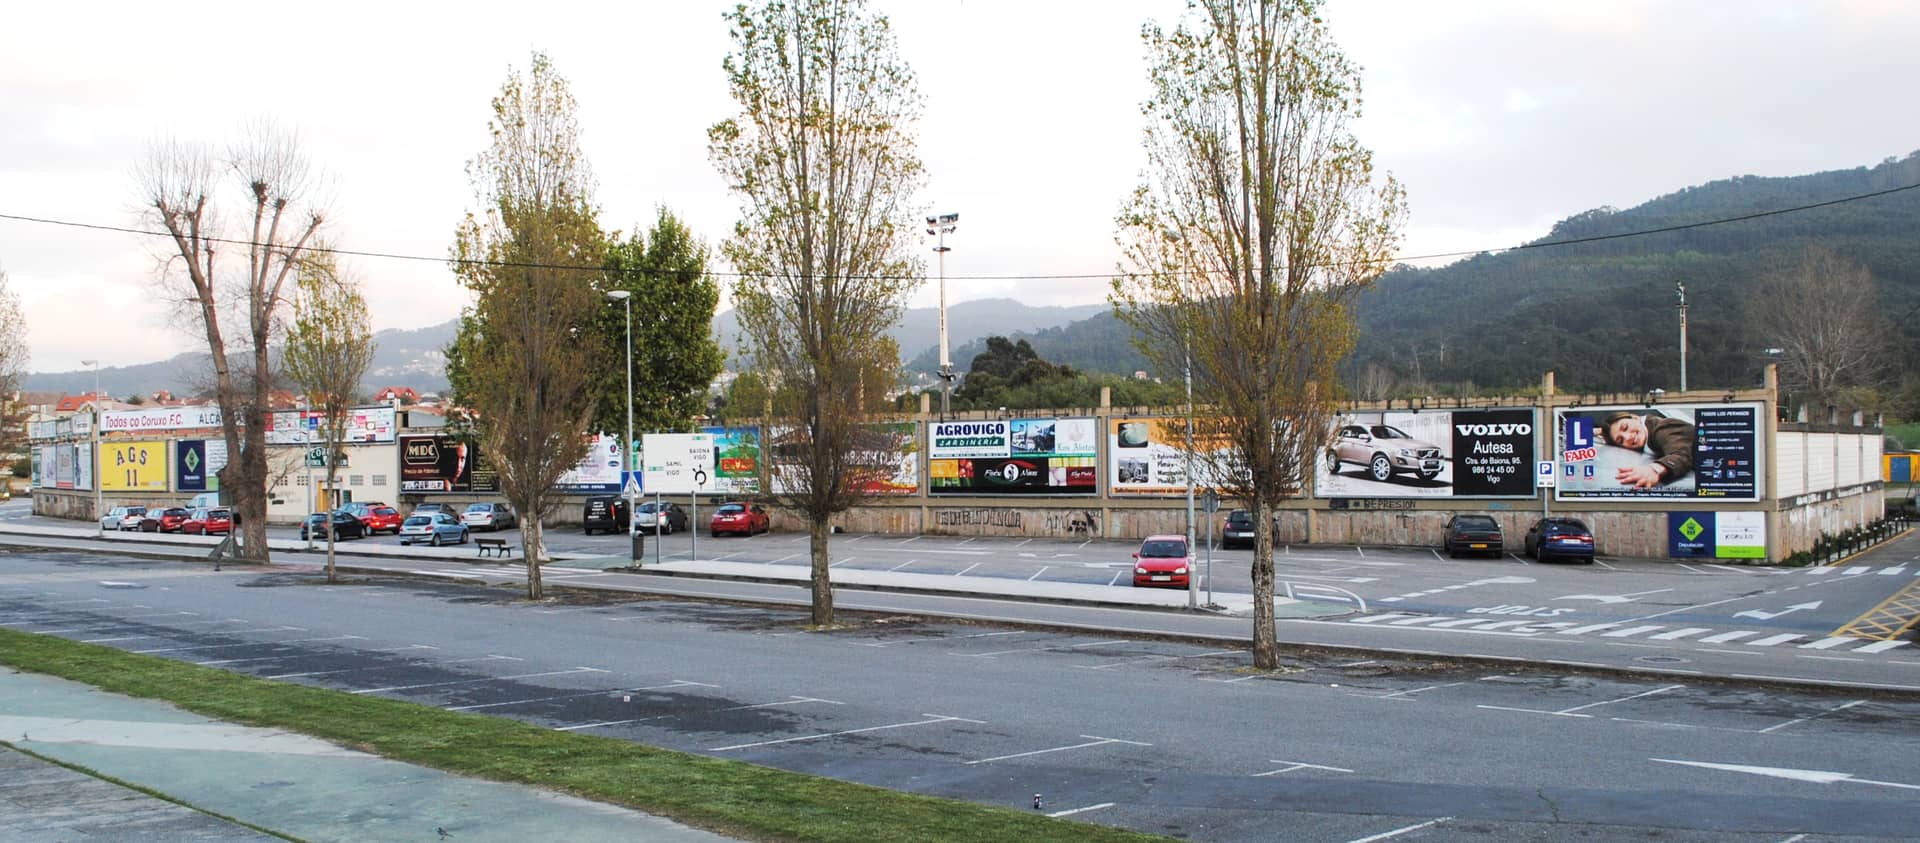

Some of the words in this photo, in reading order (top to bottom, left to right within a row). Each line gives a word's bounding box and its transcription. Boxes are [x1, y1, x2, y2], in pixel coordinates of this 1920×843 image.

[106, 416, 127, 428] Todos
[141, 416, 167, 426] Coruxo
[199, 413, 223, 424] ALCA
[936, 423, 1005, 436] AGROVIGO
[1456, 423, 1531, 436] VOLVO
[1574, 421, 1587, 445] L
[408, 445, 434, 456] MDC
[1473, 440, 1514, 454] Autesa
[1480, 457, 1488, 465] de
[1565, 449, 1596, 462] FARO
[1486, 466, 1495, 474] 24
[1496, 466, 1505, 474] 45
[1542, 464, 1550, 474] P
[127, 469, 138, 487] 11
[1487, 475, 1500, 484] Vigo
[1465, 604, 1576, 616] STOP
